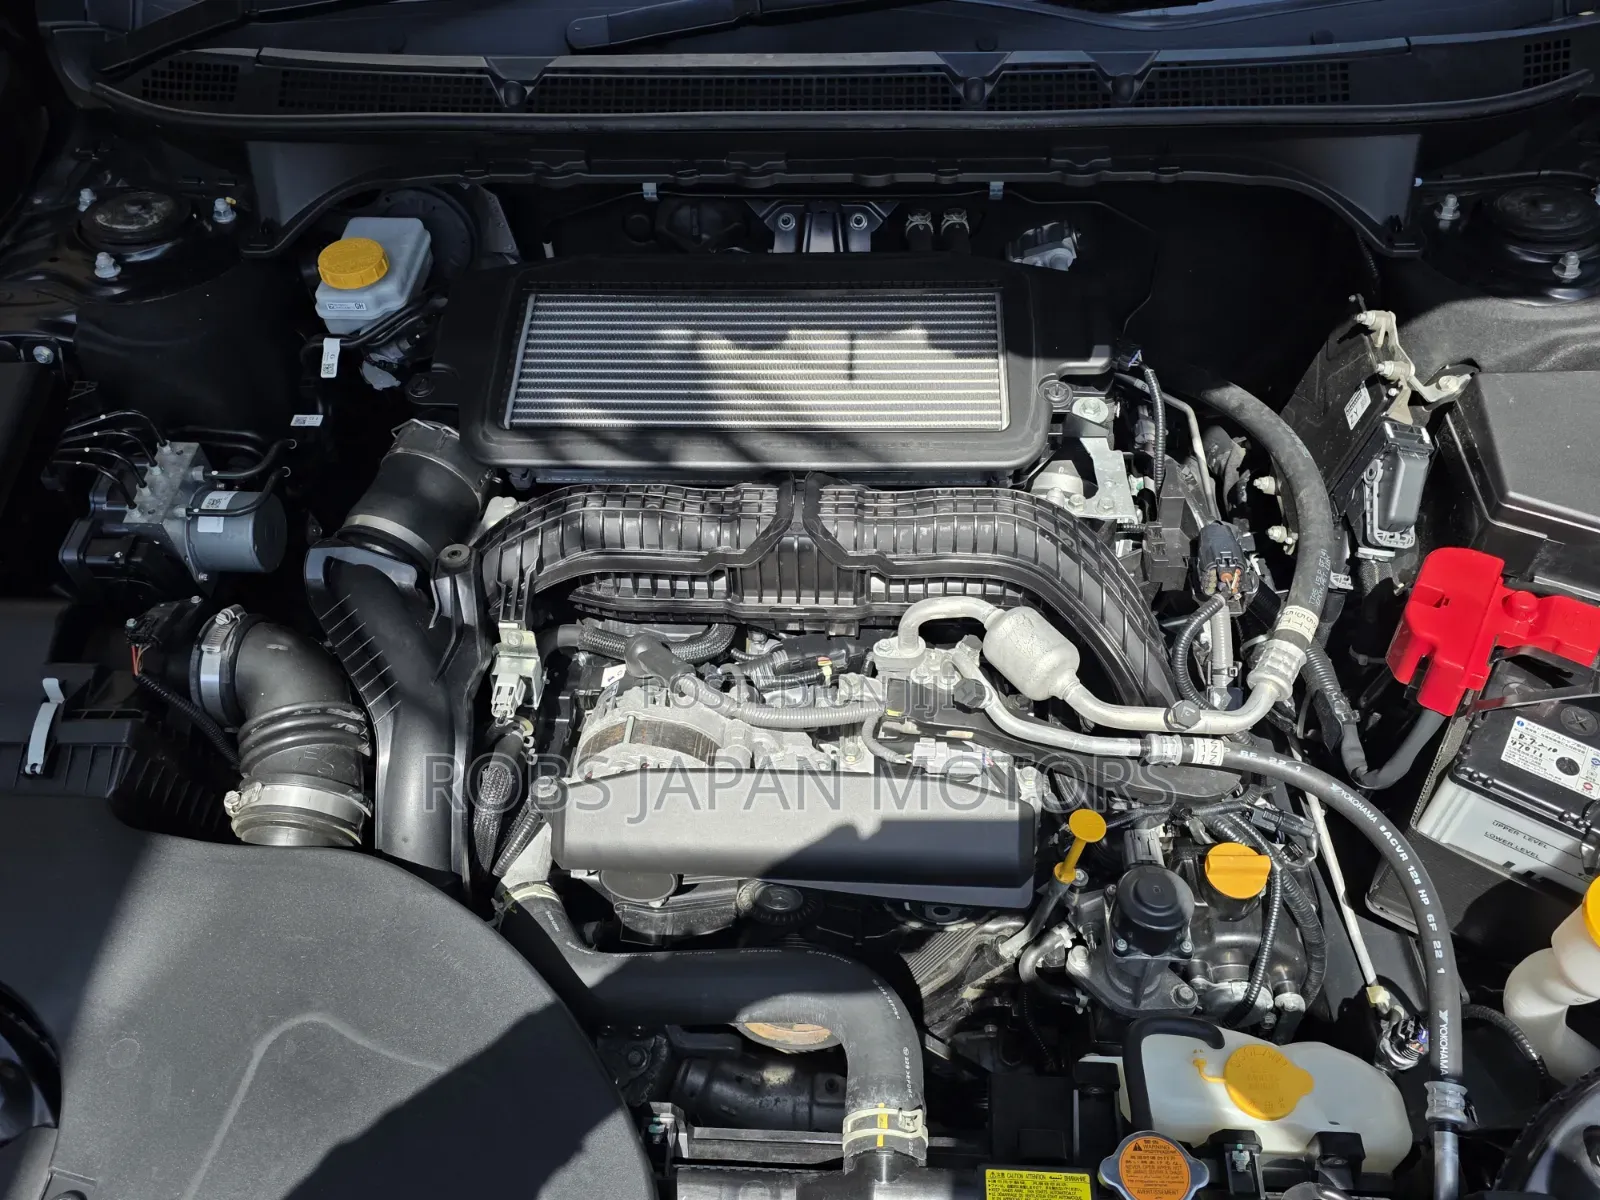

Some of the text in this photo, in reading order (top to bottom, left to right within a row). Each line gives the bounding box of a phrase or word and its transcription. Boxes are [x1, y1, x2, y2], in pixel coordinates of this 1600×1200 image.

[1484, 831, 1540, 860] LOWER LEVEL
[1492, 820, 1548, 850] UPPER LEVEL
[1340, 787, 1378, 824] YOKOHAMA
[1418, 889, 1430, 906] HP
[1426, 914, 1438, 932] 6F
[1432, 940, 1444, 959] 22
[1439, 1024, 1449, 1077] YOKOHAMA
